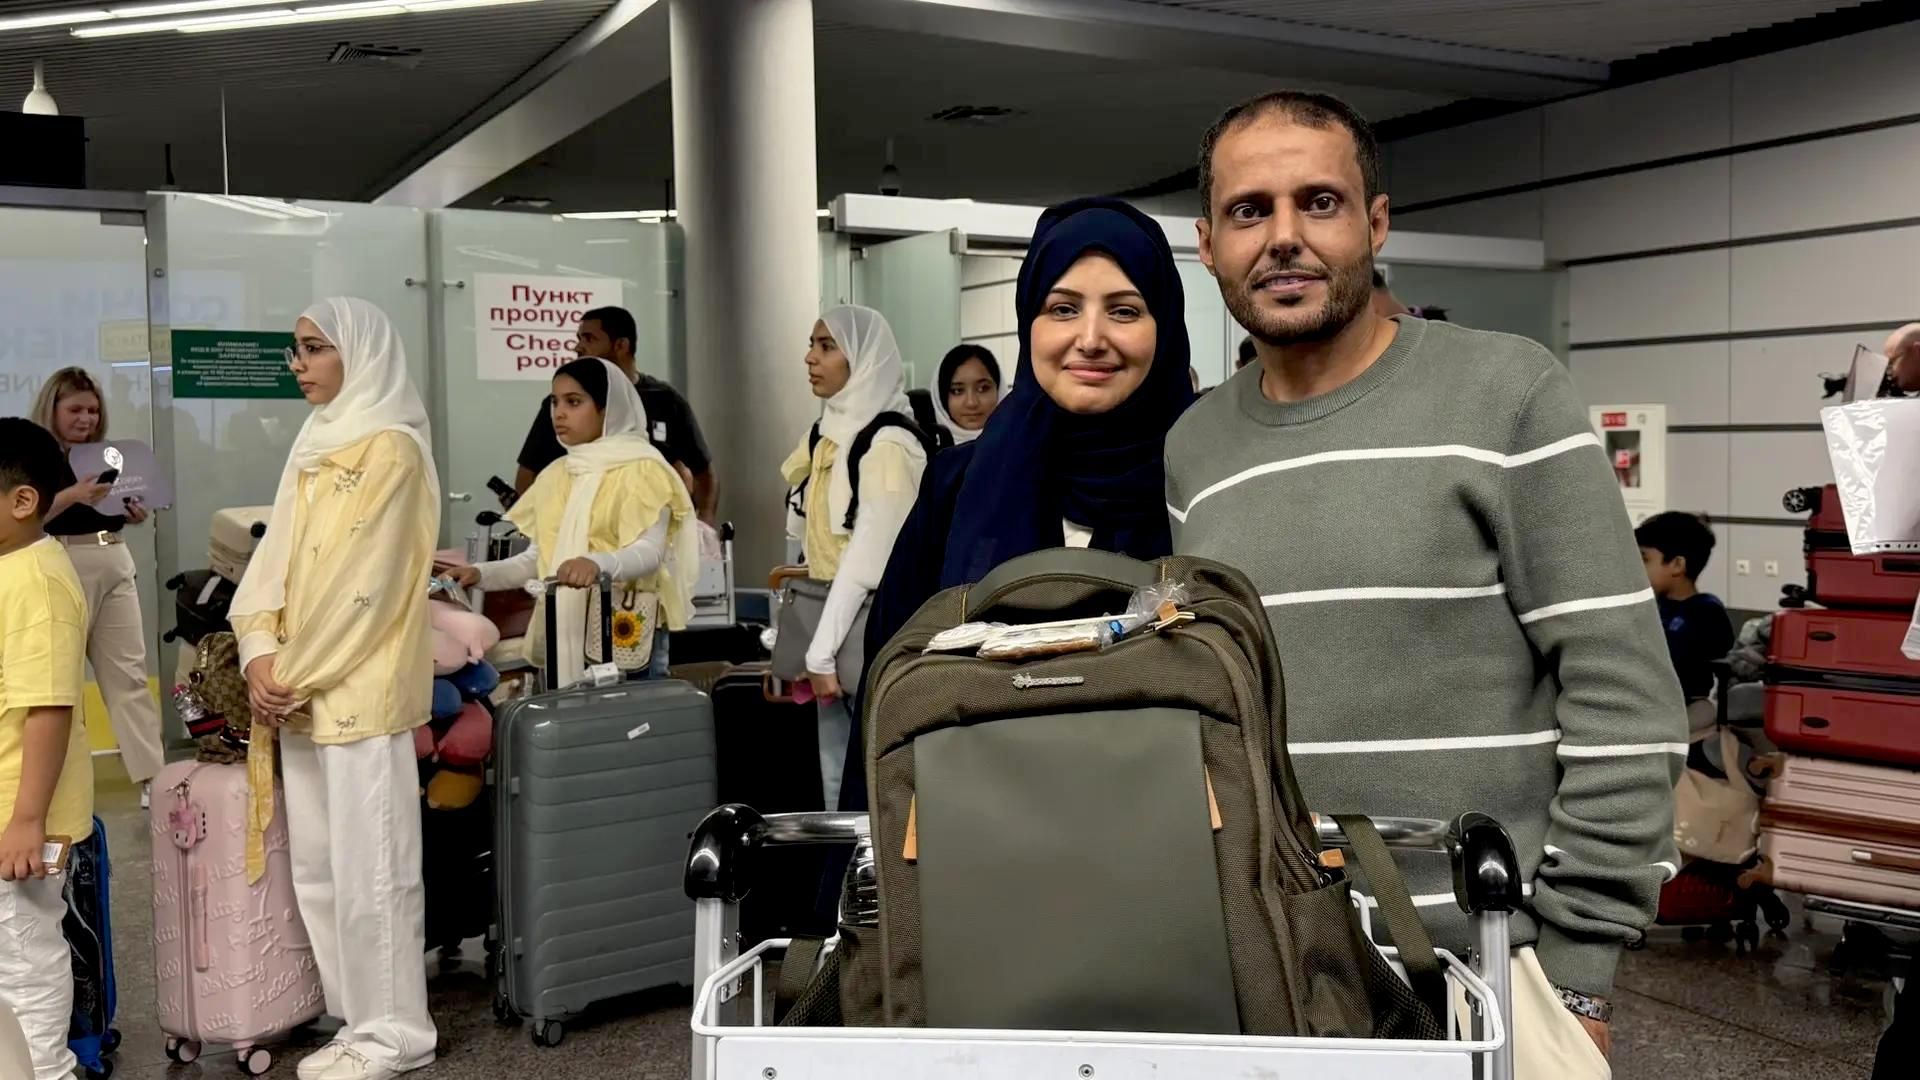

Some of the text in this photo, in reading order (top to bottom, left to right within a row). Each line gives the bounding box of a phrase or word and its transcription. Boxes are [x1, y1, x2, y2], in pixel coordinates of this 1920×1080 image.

[512, 285, 594, 306] Пункт
[490, 307, 584, 327] пропус
[506, 333, 578, 352] Chec
[516, 353, 574, 371] poin
